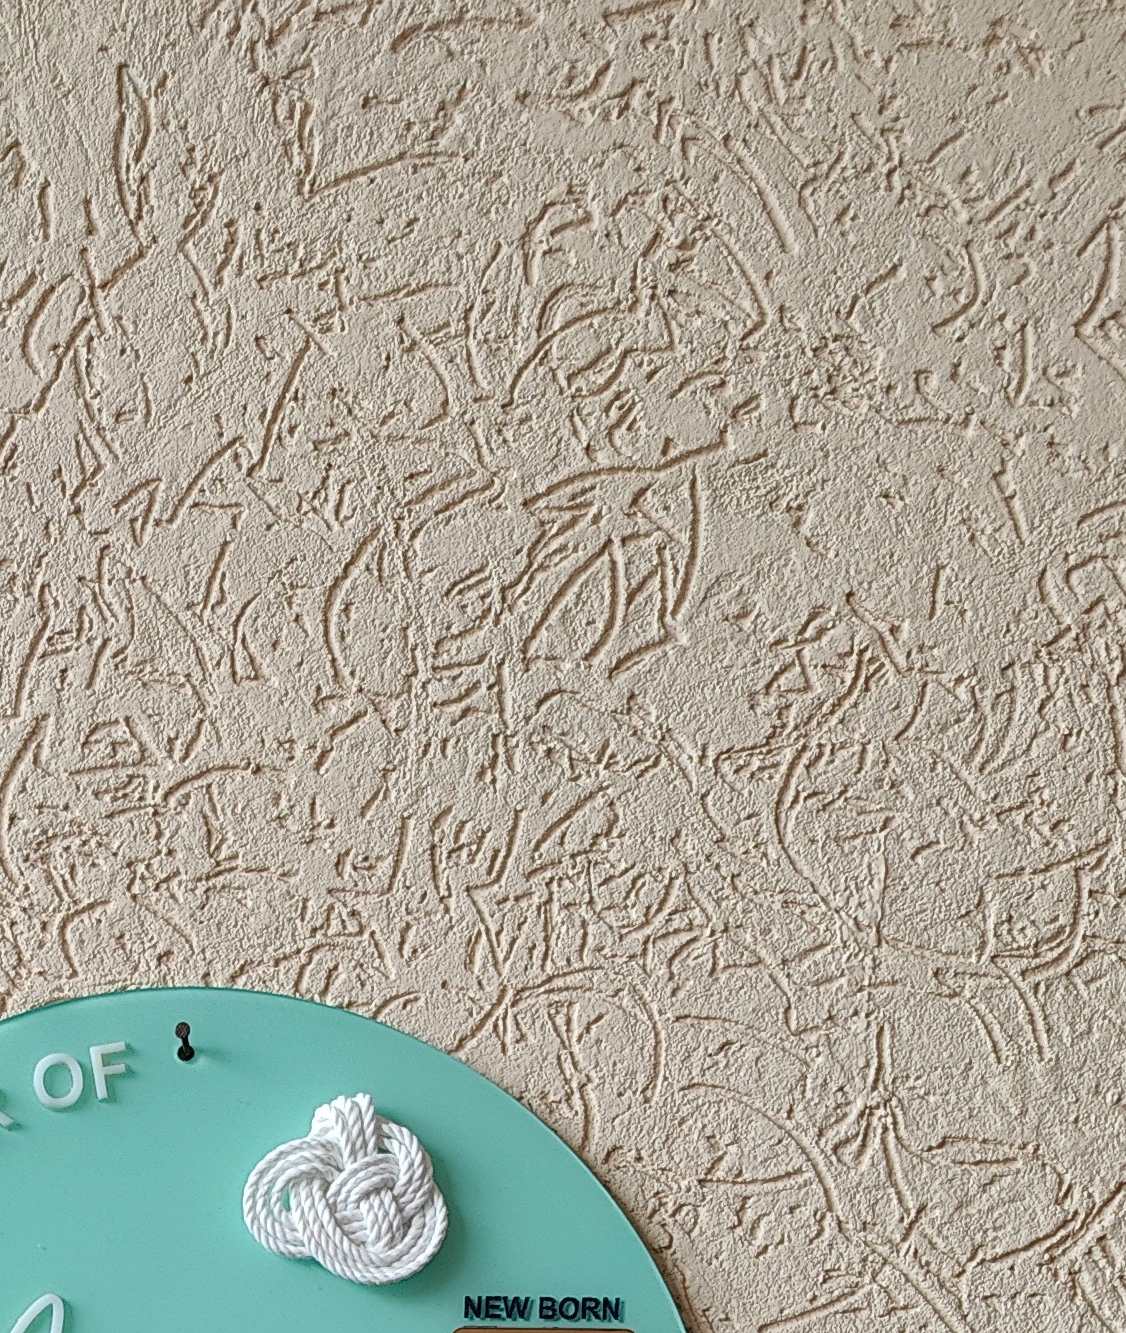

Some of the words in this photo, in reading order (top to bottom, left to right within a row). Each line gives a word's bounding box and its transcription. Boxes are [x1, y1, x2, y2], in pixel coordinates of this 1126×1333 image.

[32, 1041, 128, 1110] OF
[462, 1295, 533, 1320] NEW
[538, 1296, 621, 1321] BORN
